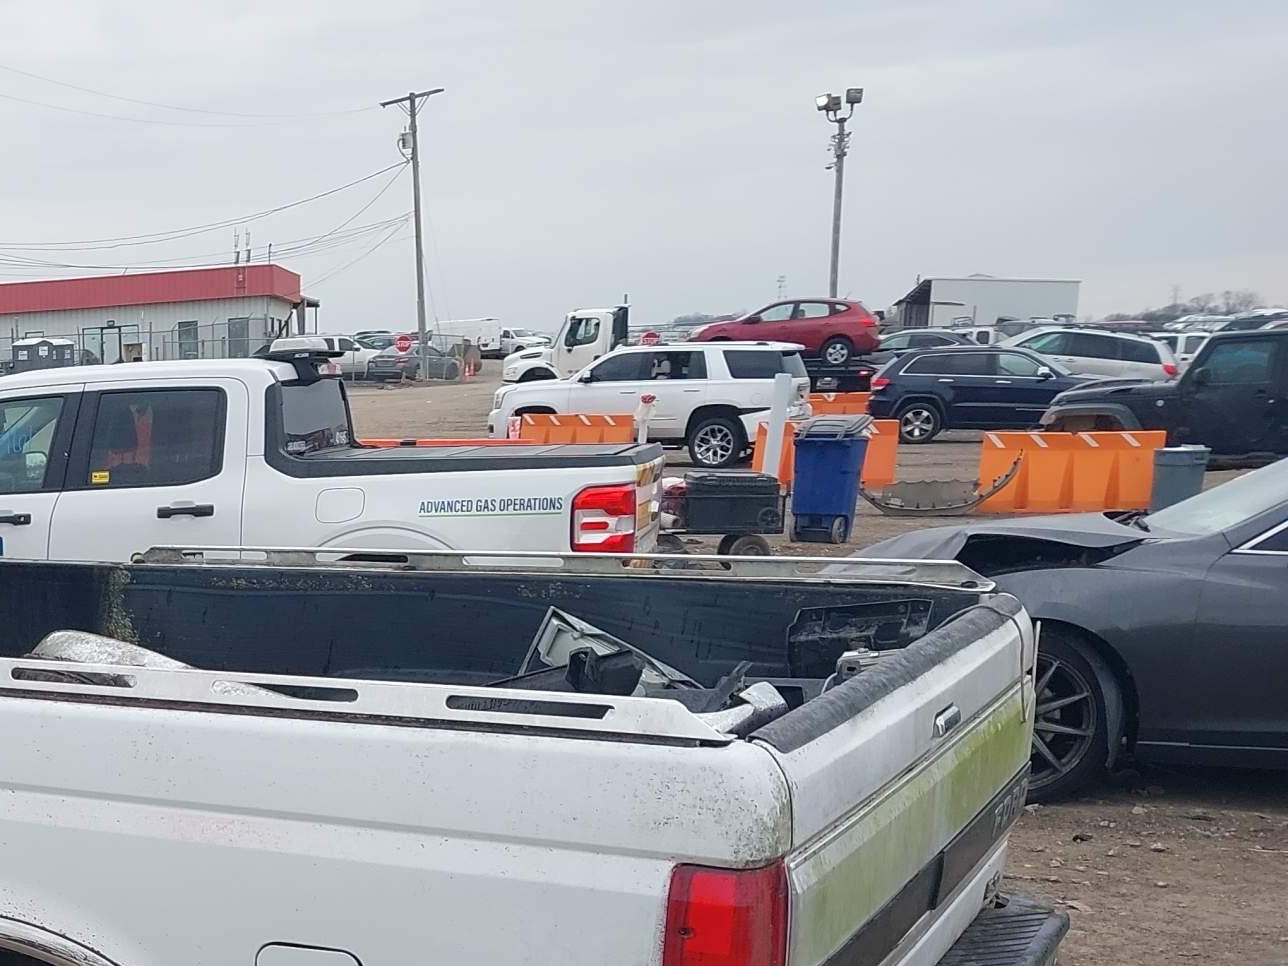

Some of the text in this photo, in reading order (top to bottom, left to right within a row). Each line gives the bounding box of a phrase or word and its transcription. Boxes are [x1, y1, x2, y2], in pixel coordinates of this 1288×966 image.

[419, 497, 563, 514] ADVANCED GAS OPERATIONS
